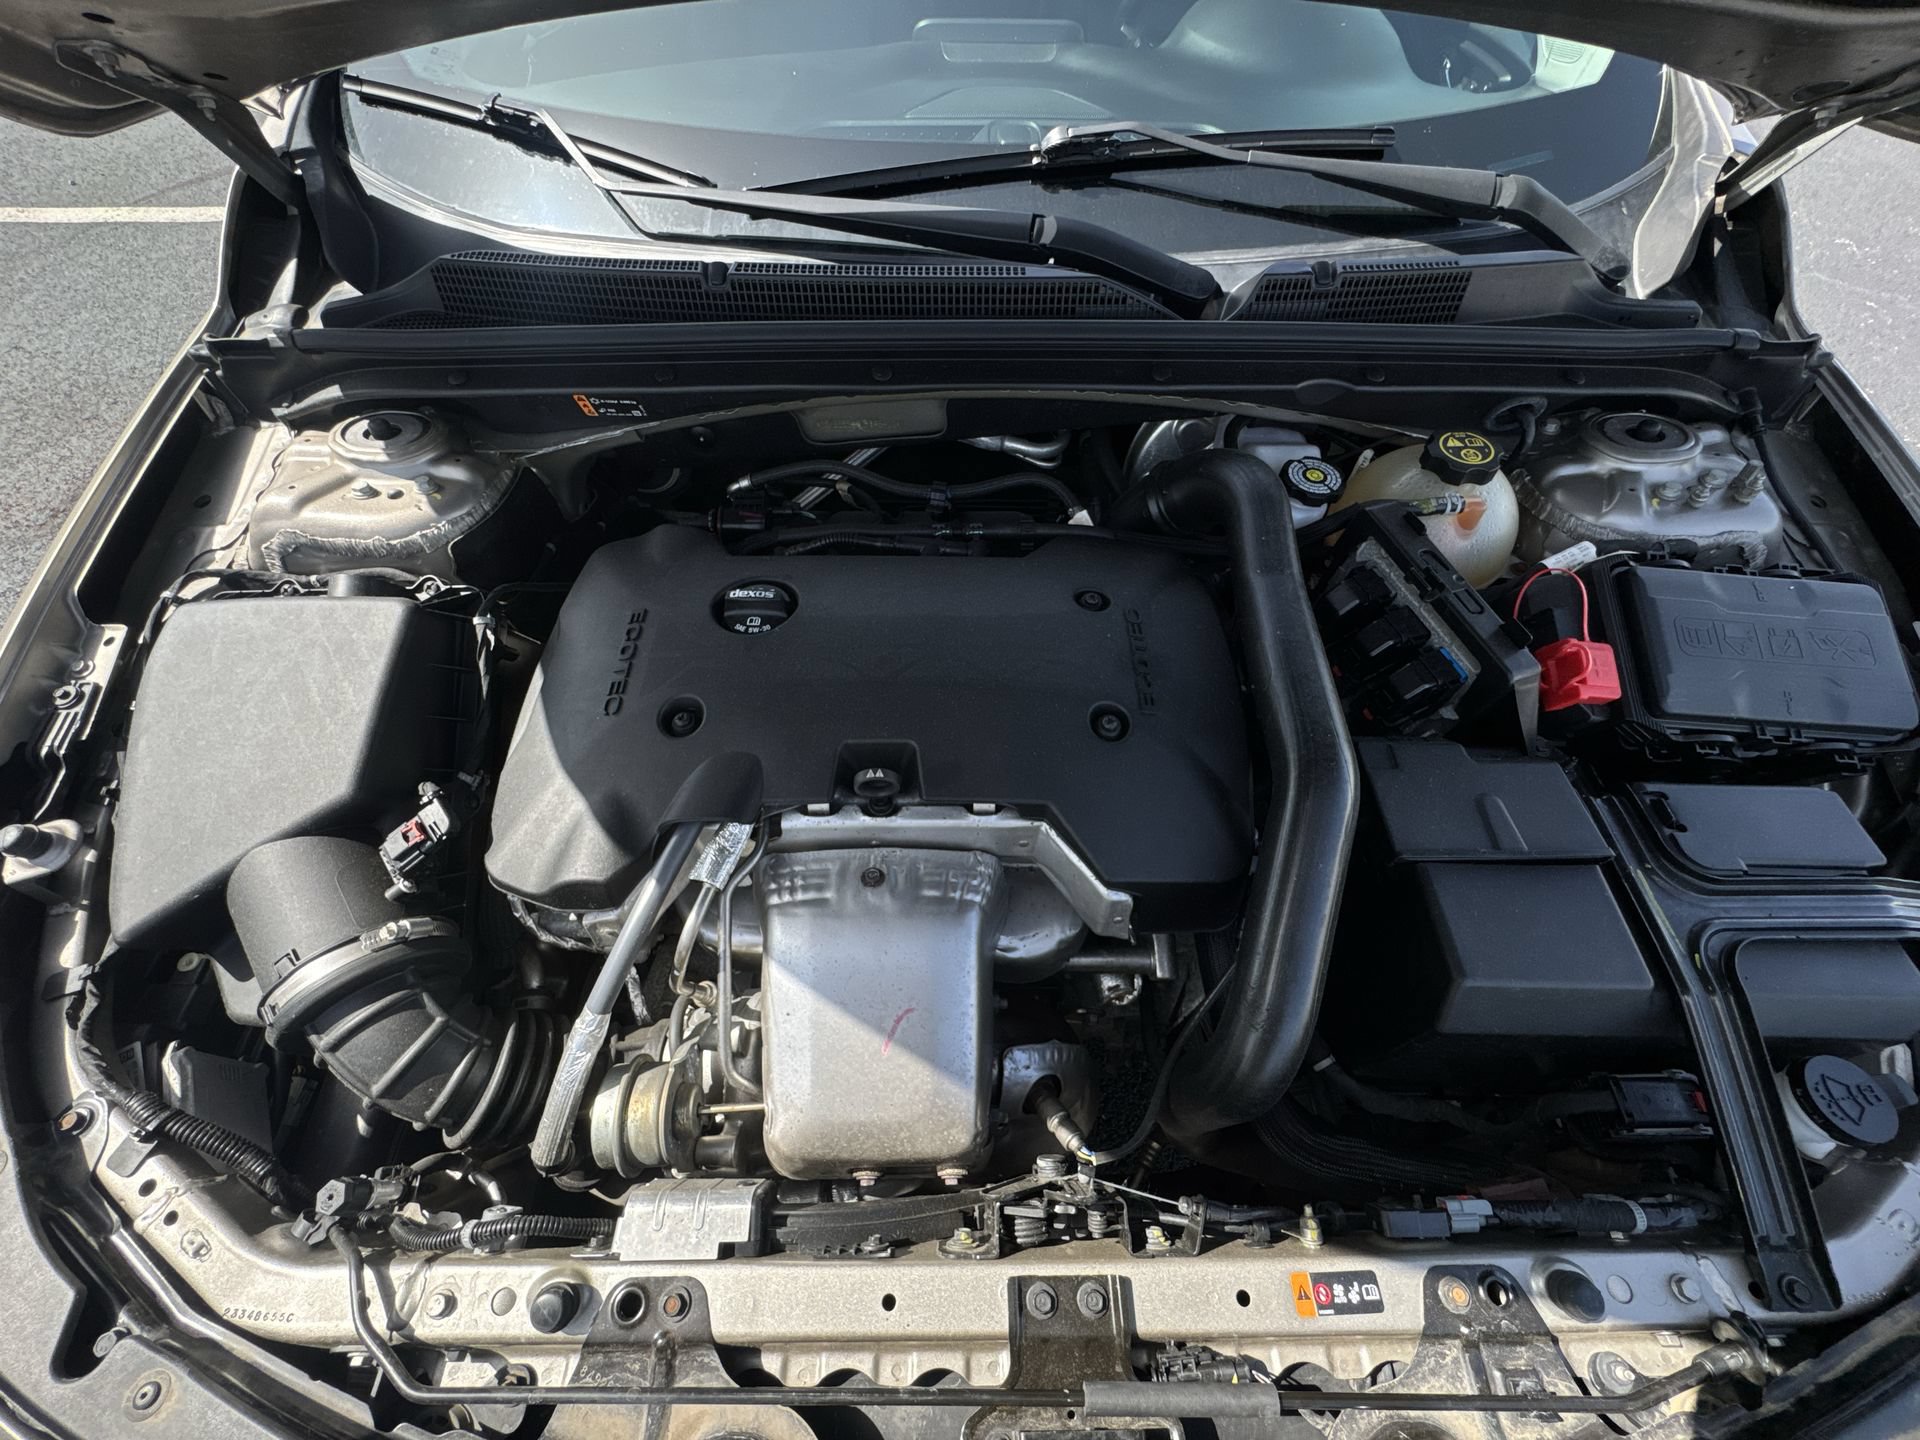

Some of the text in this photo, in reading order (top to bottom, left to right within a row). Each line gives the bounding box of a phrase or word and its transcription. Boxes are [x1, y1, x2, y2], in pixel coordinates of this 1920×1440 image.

[729, 588, 776, 599] dexos
[733, 622, 747, 633] SAE
[602, 607, 649, 717] ECOTEC
